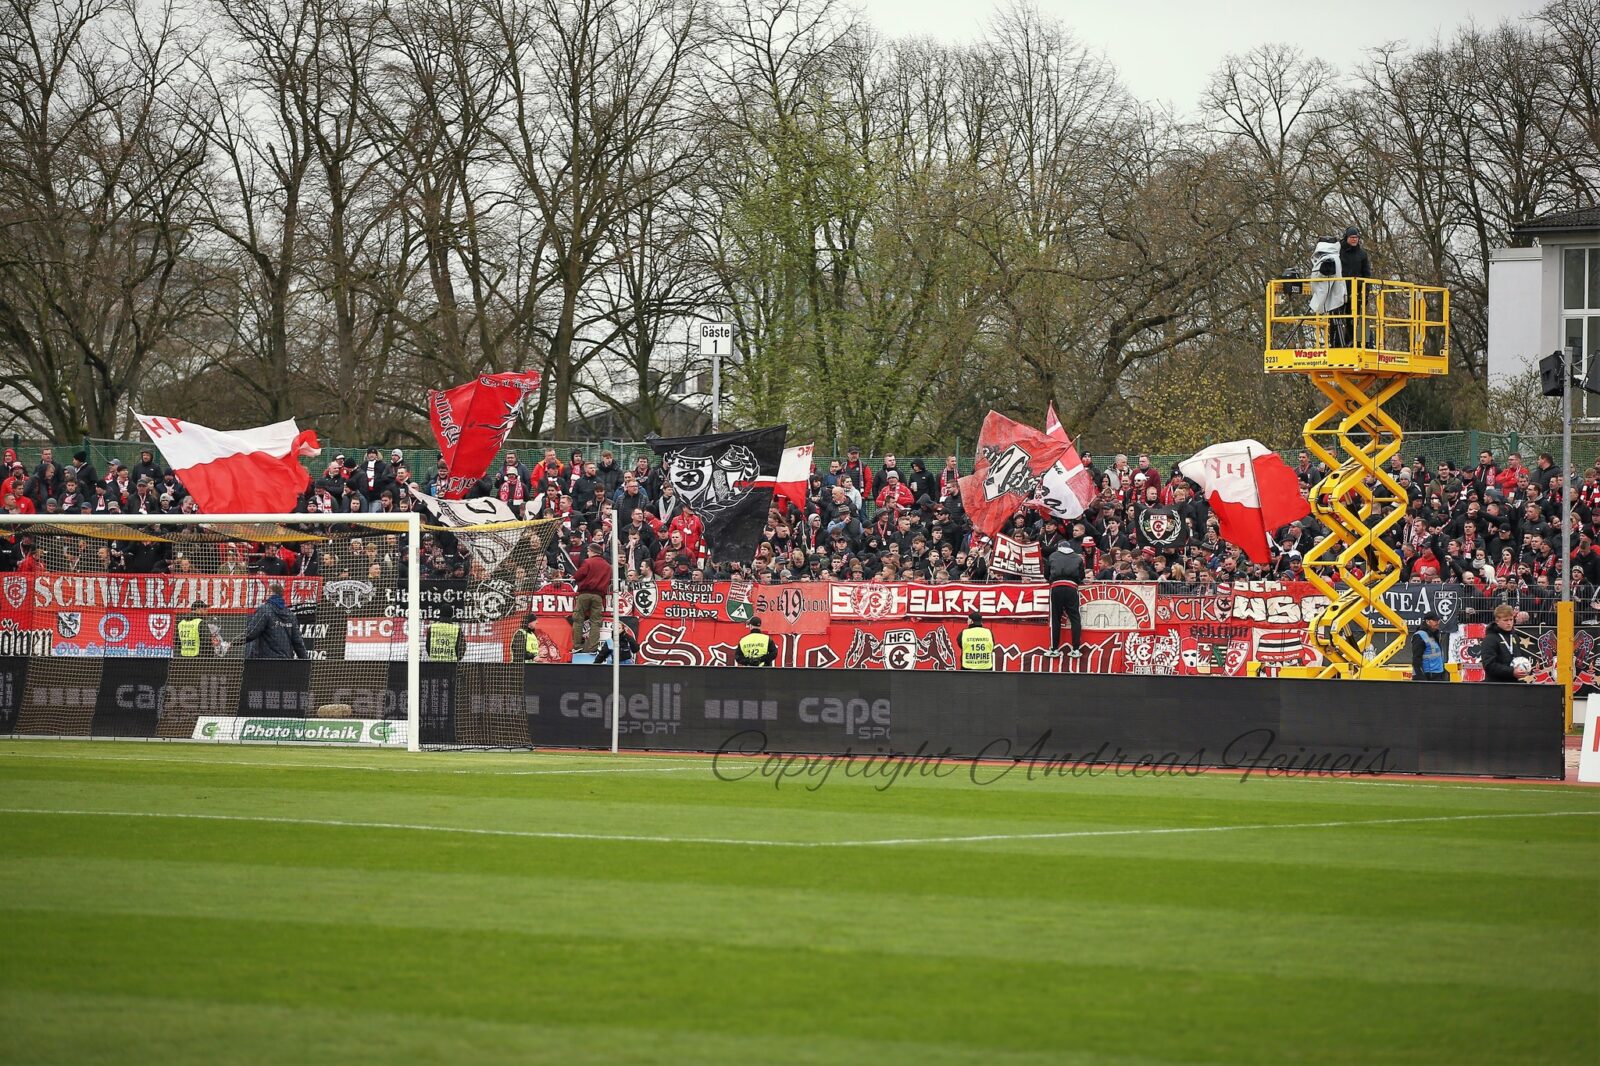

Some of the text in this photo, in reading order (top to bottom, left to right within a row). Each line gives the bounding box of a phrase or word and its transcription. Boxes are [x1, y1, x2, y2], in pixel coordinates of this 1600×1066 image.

[703, 325, 730, 338] Gäste
[713, 339, 718, 354] 1
[1294, 350, 1327, 358] Wagert
[1293, 359, 1328, 368] www.wagert.de
[994, 537, 1040, 564] HFC
[993, 556, 1041, 574] CHEMIE
[672, 582, 714, 592] SEKTION
[660, 590, 724, 604] MANSFELD
[910, 586, 1050, 613] SURREALE
[452, 605, 482, 618] alle
[1079, 586, 1150, 628] ATHONTOR
[346, 620, 394, 637] HFC
[888, 632, 912, 643] HFC
[970, 643, 986, 652] 156
[560, 683, 681, 729] capelli
[244, 723, 359, 740] Photo voltaik
[617, 721, 680, 734] SPORT
